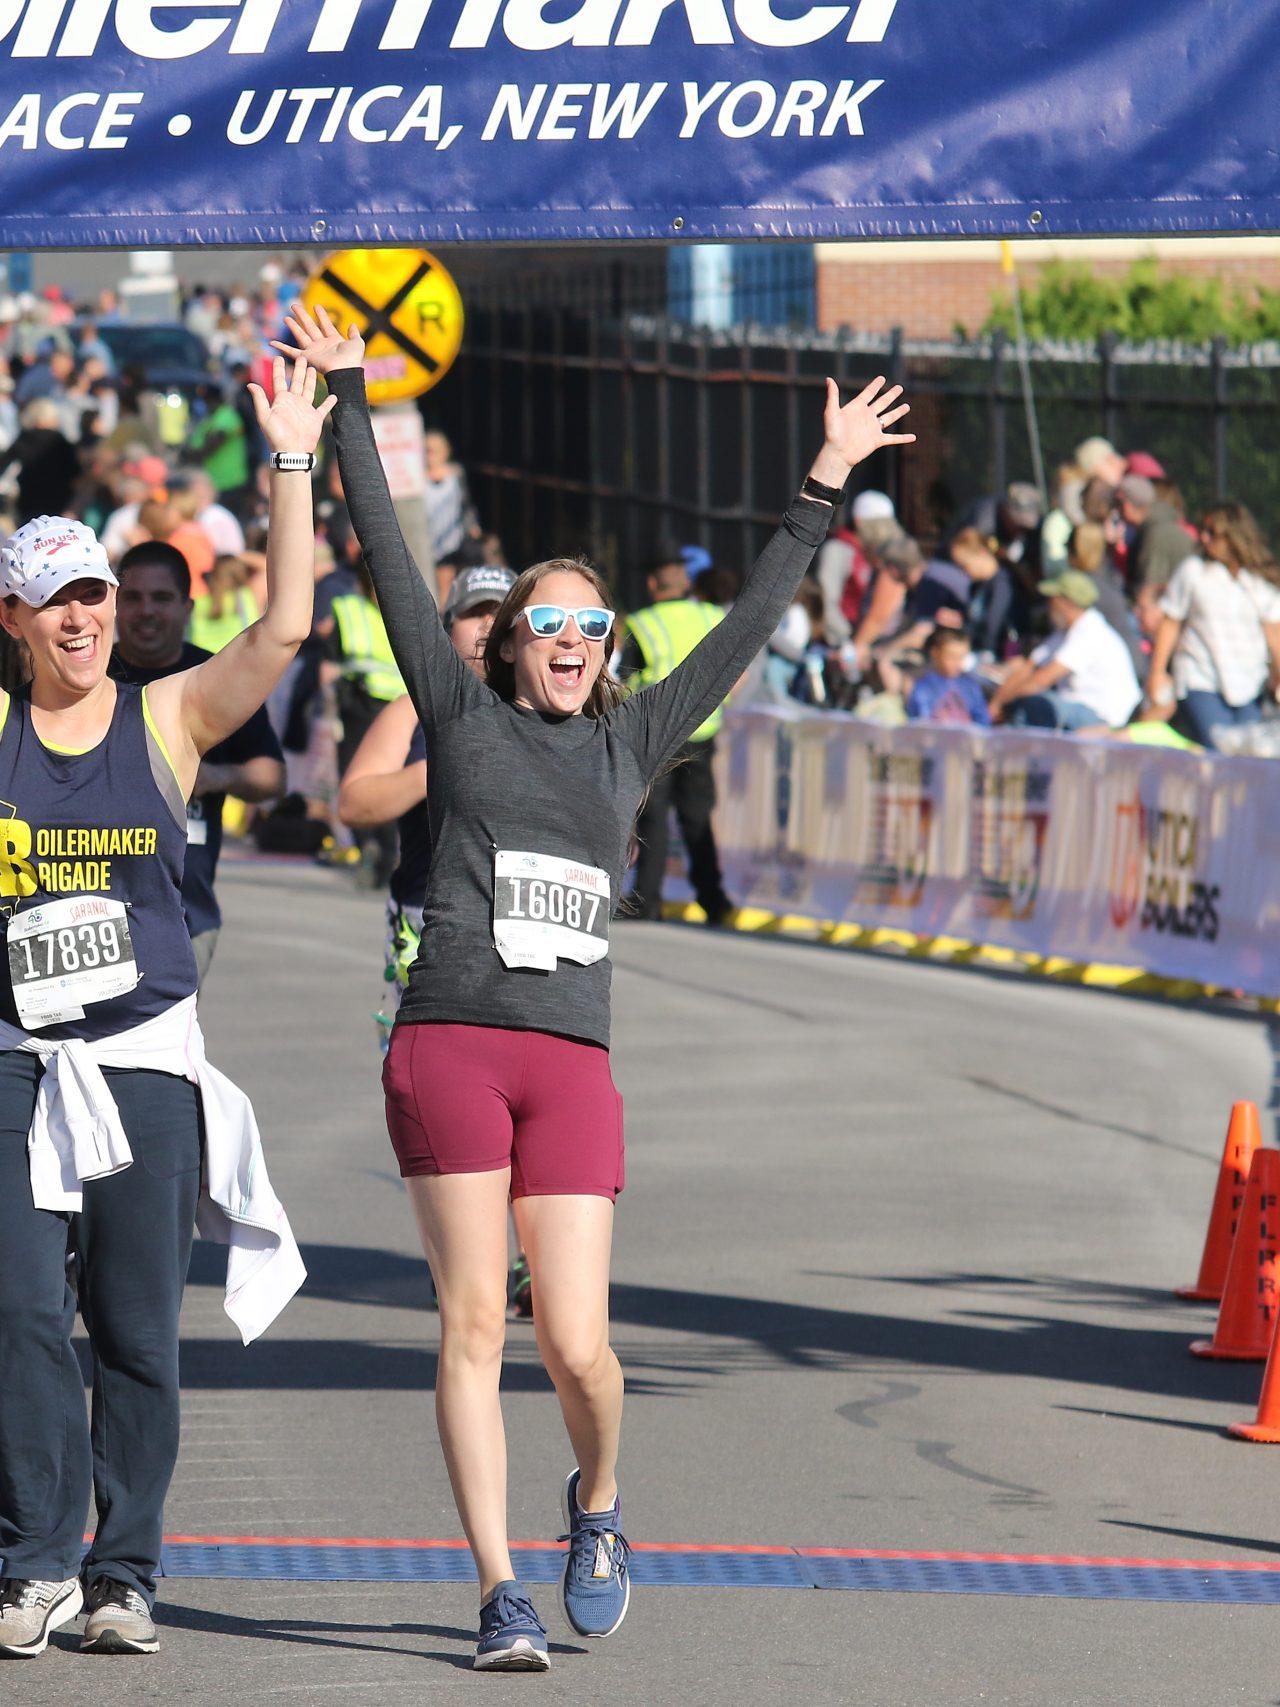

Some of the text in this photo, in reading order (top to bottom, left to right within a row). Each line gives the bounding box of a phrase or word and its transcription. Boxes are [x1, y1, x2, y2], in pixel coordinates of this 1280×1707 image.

[226, 80, 885, 151] UTICA, NEW YORK
[419, 300, 445, 333] R
[33, 534, 80, 552] RUN USA
[562, 868, 600, 891] SARANAC
[69, 901, 111, 923] SARANAC
[507, 876, 601, 933] 16087
[19, 921, 122, 980] 17839
